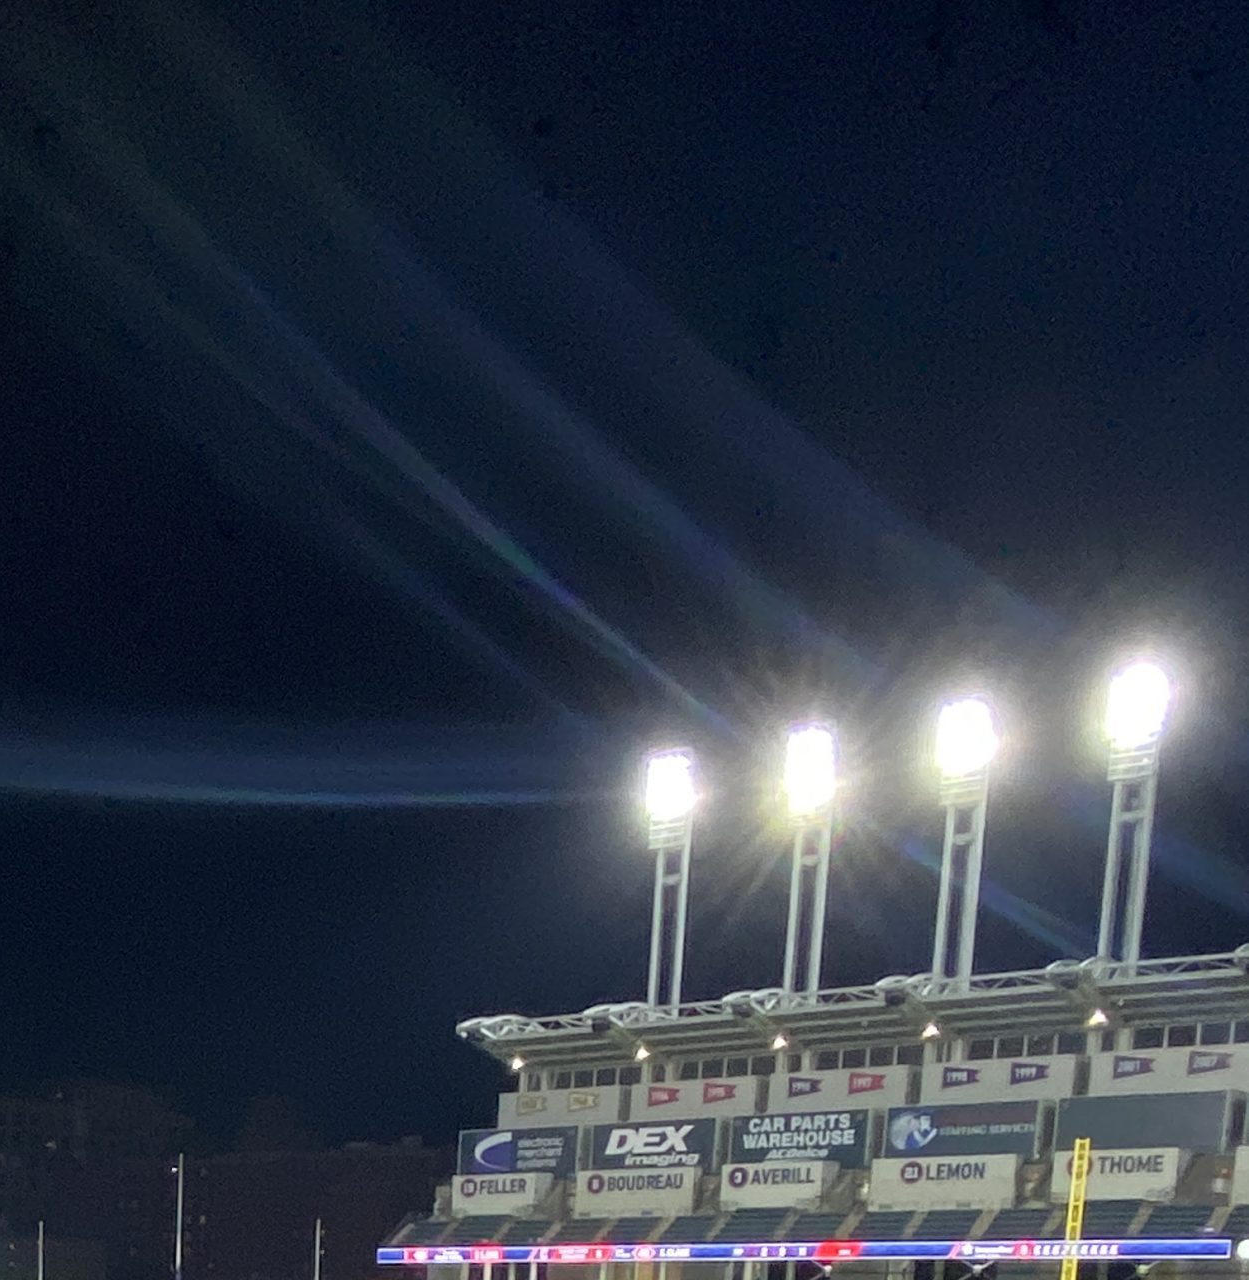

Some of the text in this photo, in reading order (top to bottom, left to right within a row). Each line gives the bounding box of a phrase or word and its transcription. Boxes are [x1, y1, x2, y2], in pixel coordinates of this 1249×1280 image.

[749, 1113, 851, 1133] CAR PARTS
[604, 1125, 695, 1156] DEX
[743, 1129, 855, 1149] WAREHOUSE
[624, 1152, 699, 1167] imaging
[1098, 1155, 1164, 1174] THOME
[751, 1168, 815, 1185] AVERILL
[925, 1162, 986, 1181] LEMON
[479, 1178, 527, 1195] FELLER
[607, 1173, 684, 1192] BOUDREAU
